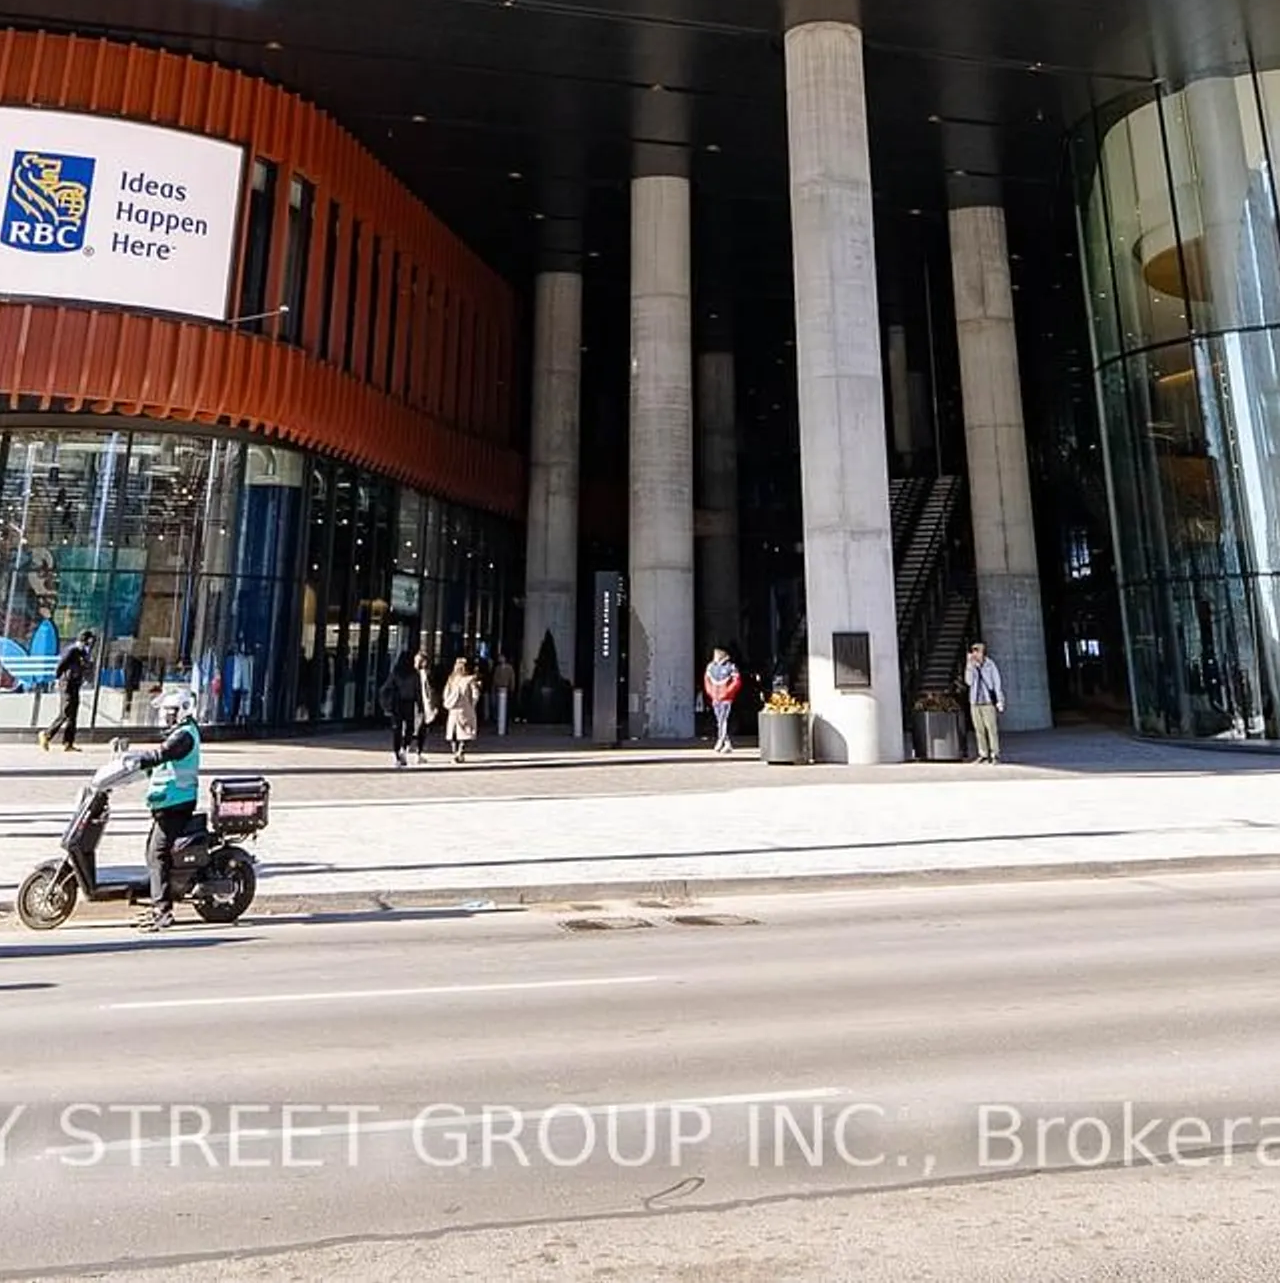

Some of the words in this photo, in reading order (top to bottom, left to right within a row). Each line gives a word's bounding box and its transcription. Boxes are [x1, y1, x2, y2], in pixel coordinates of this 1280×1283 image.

[119, 170, 188, 202] Ideas
[115, 200, 208, 236] Happen
[8, 221, 79, 248] RBC
[111, 232, 174, 261] Here
